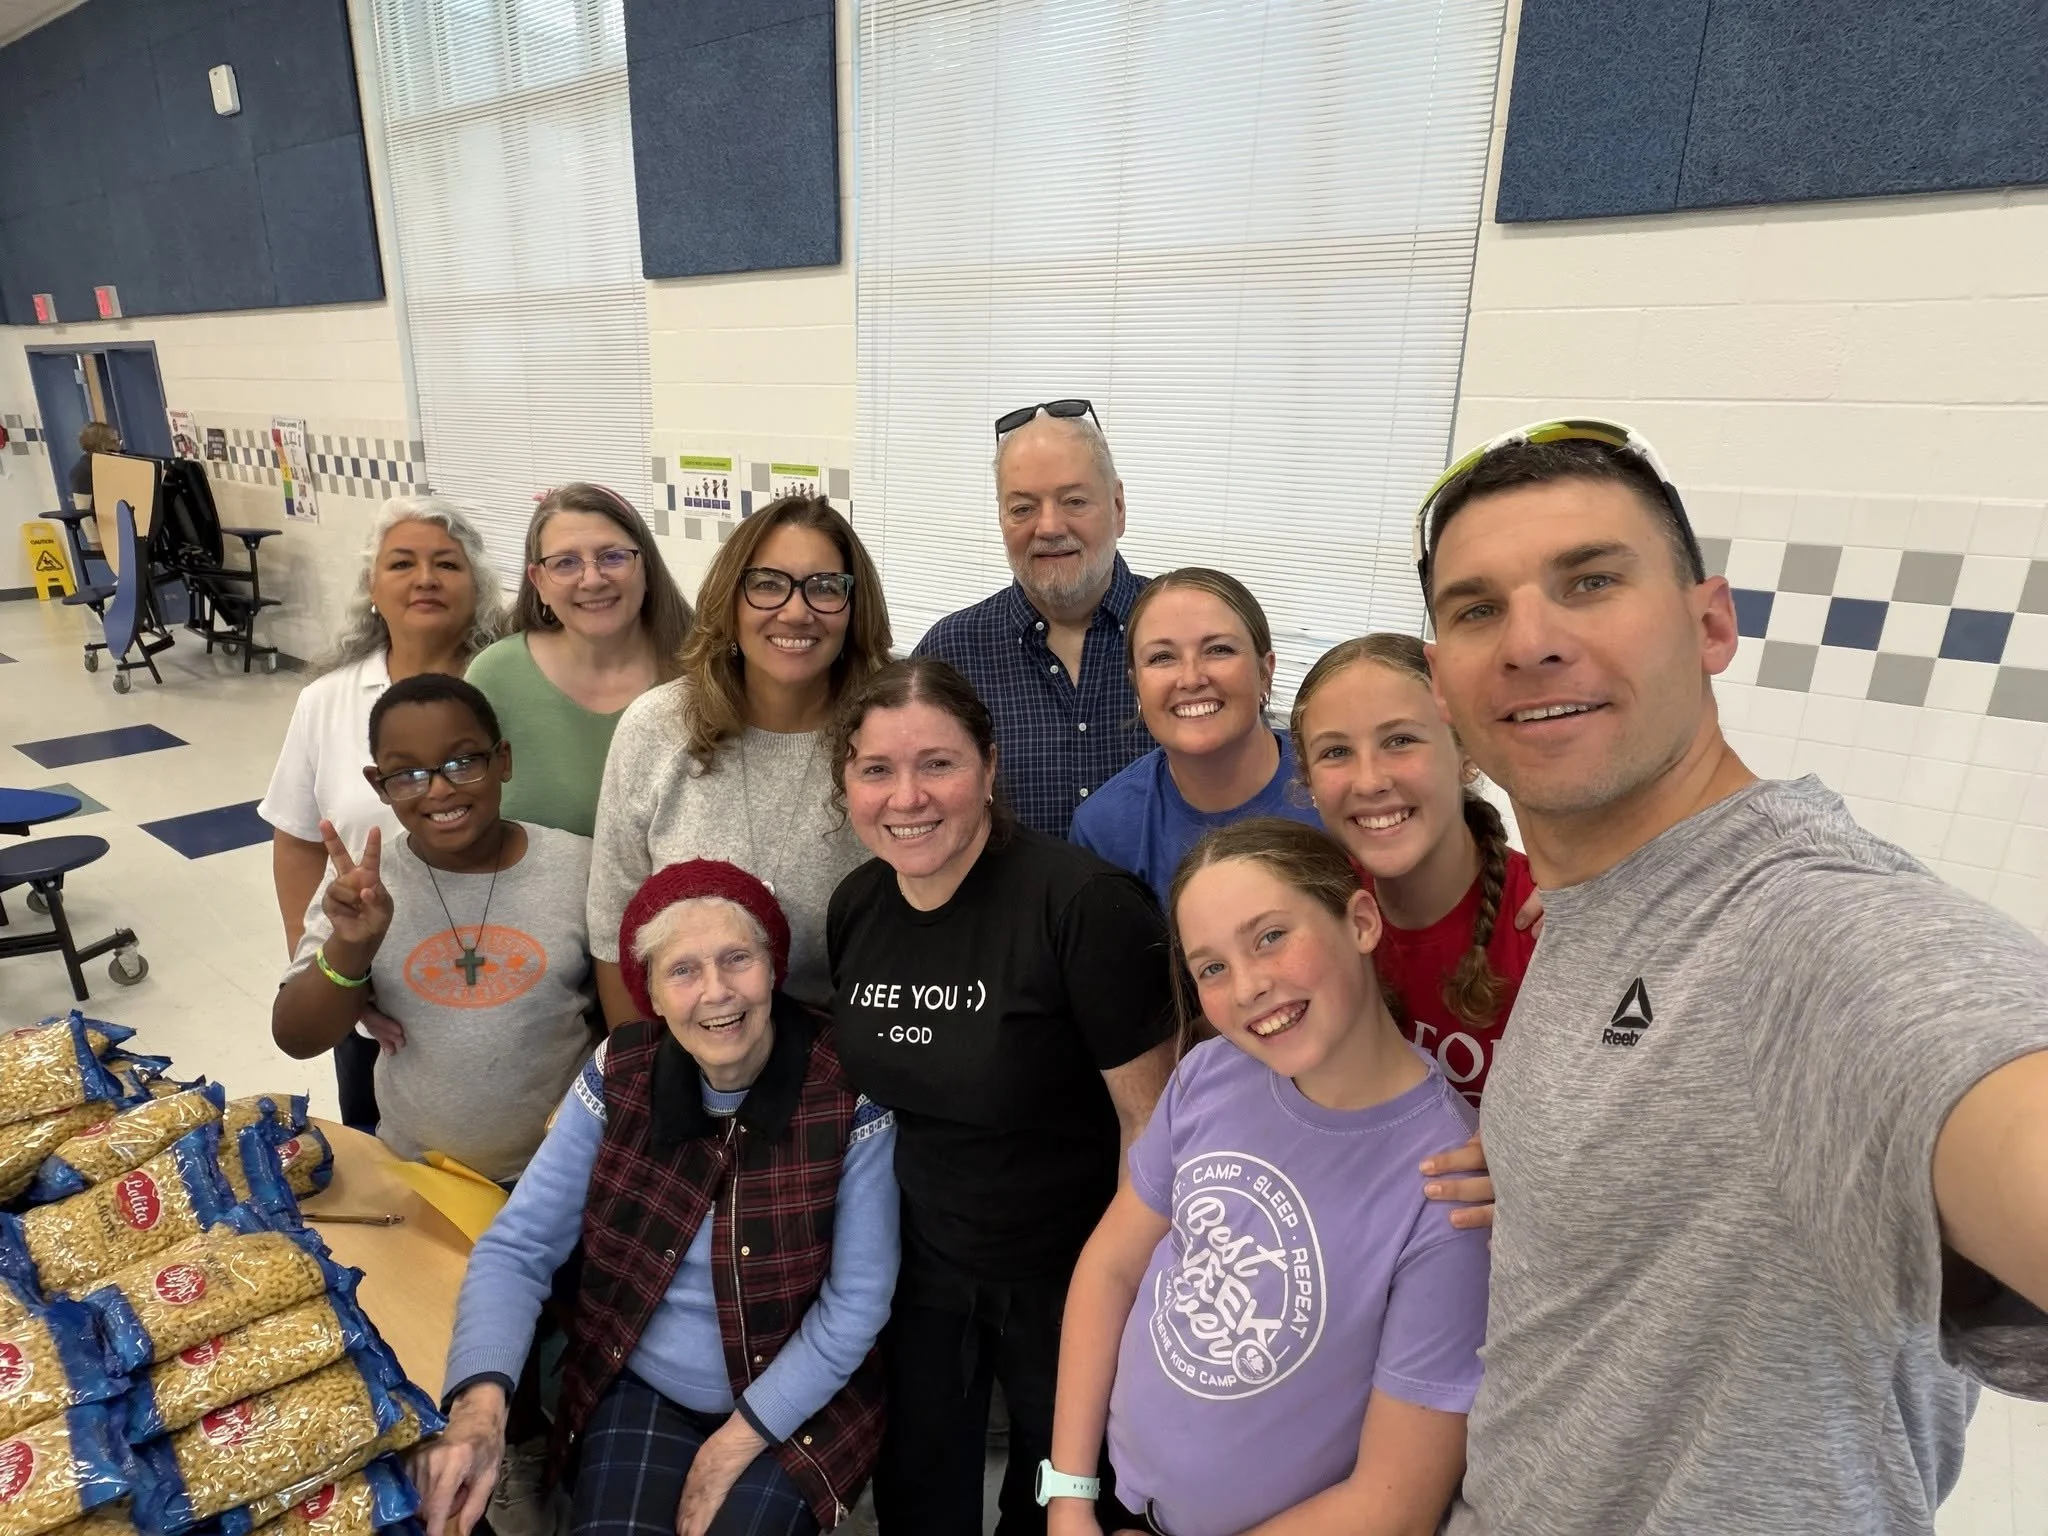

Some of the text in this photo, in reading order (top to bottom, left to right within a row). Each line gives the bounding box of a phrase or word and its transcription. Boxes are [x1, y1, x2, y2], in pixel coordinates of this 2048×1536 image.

[850, 979, 987, 1012] I SEE YOU ;)
[889, 1025, 933, 1045] GOD
[1601, 1028, 1643, 1047] Reeb
[124, 1179, 149, 1225] Lolita
[1186, 1196, 1289, 1278] Best
[1193, 1164, 1313, 1339] CAMP SLEEP REPEAT
[1199, 1370, 1237, 1387] CAMP
